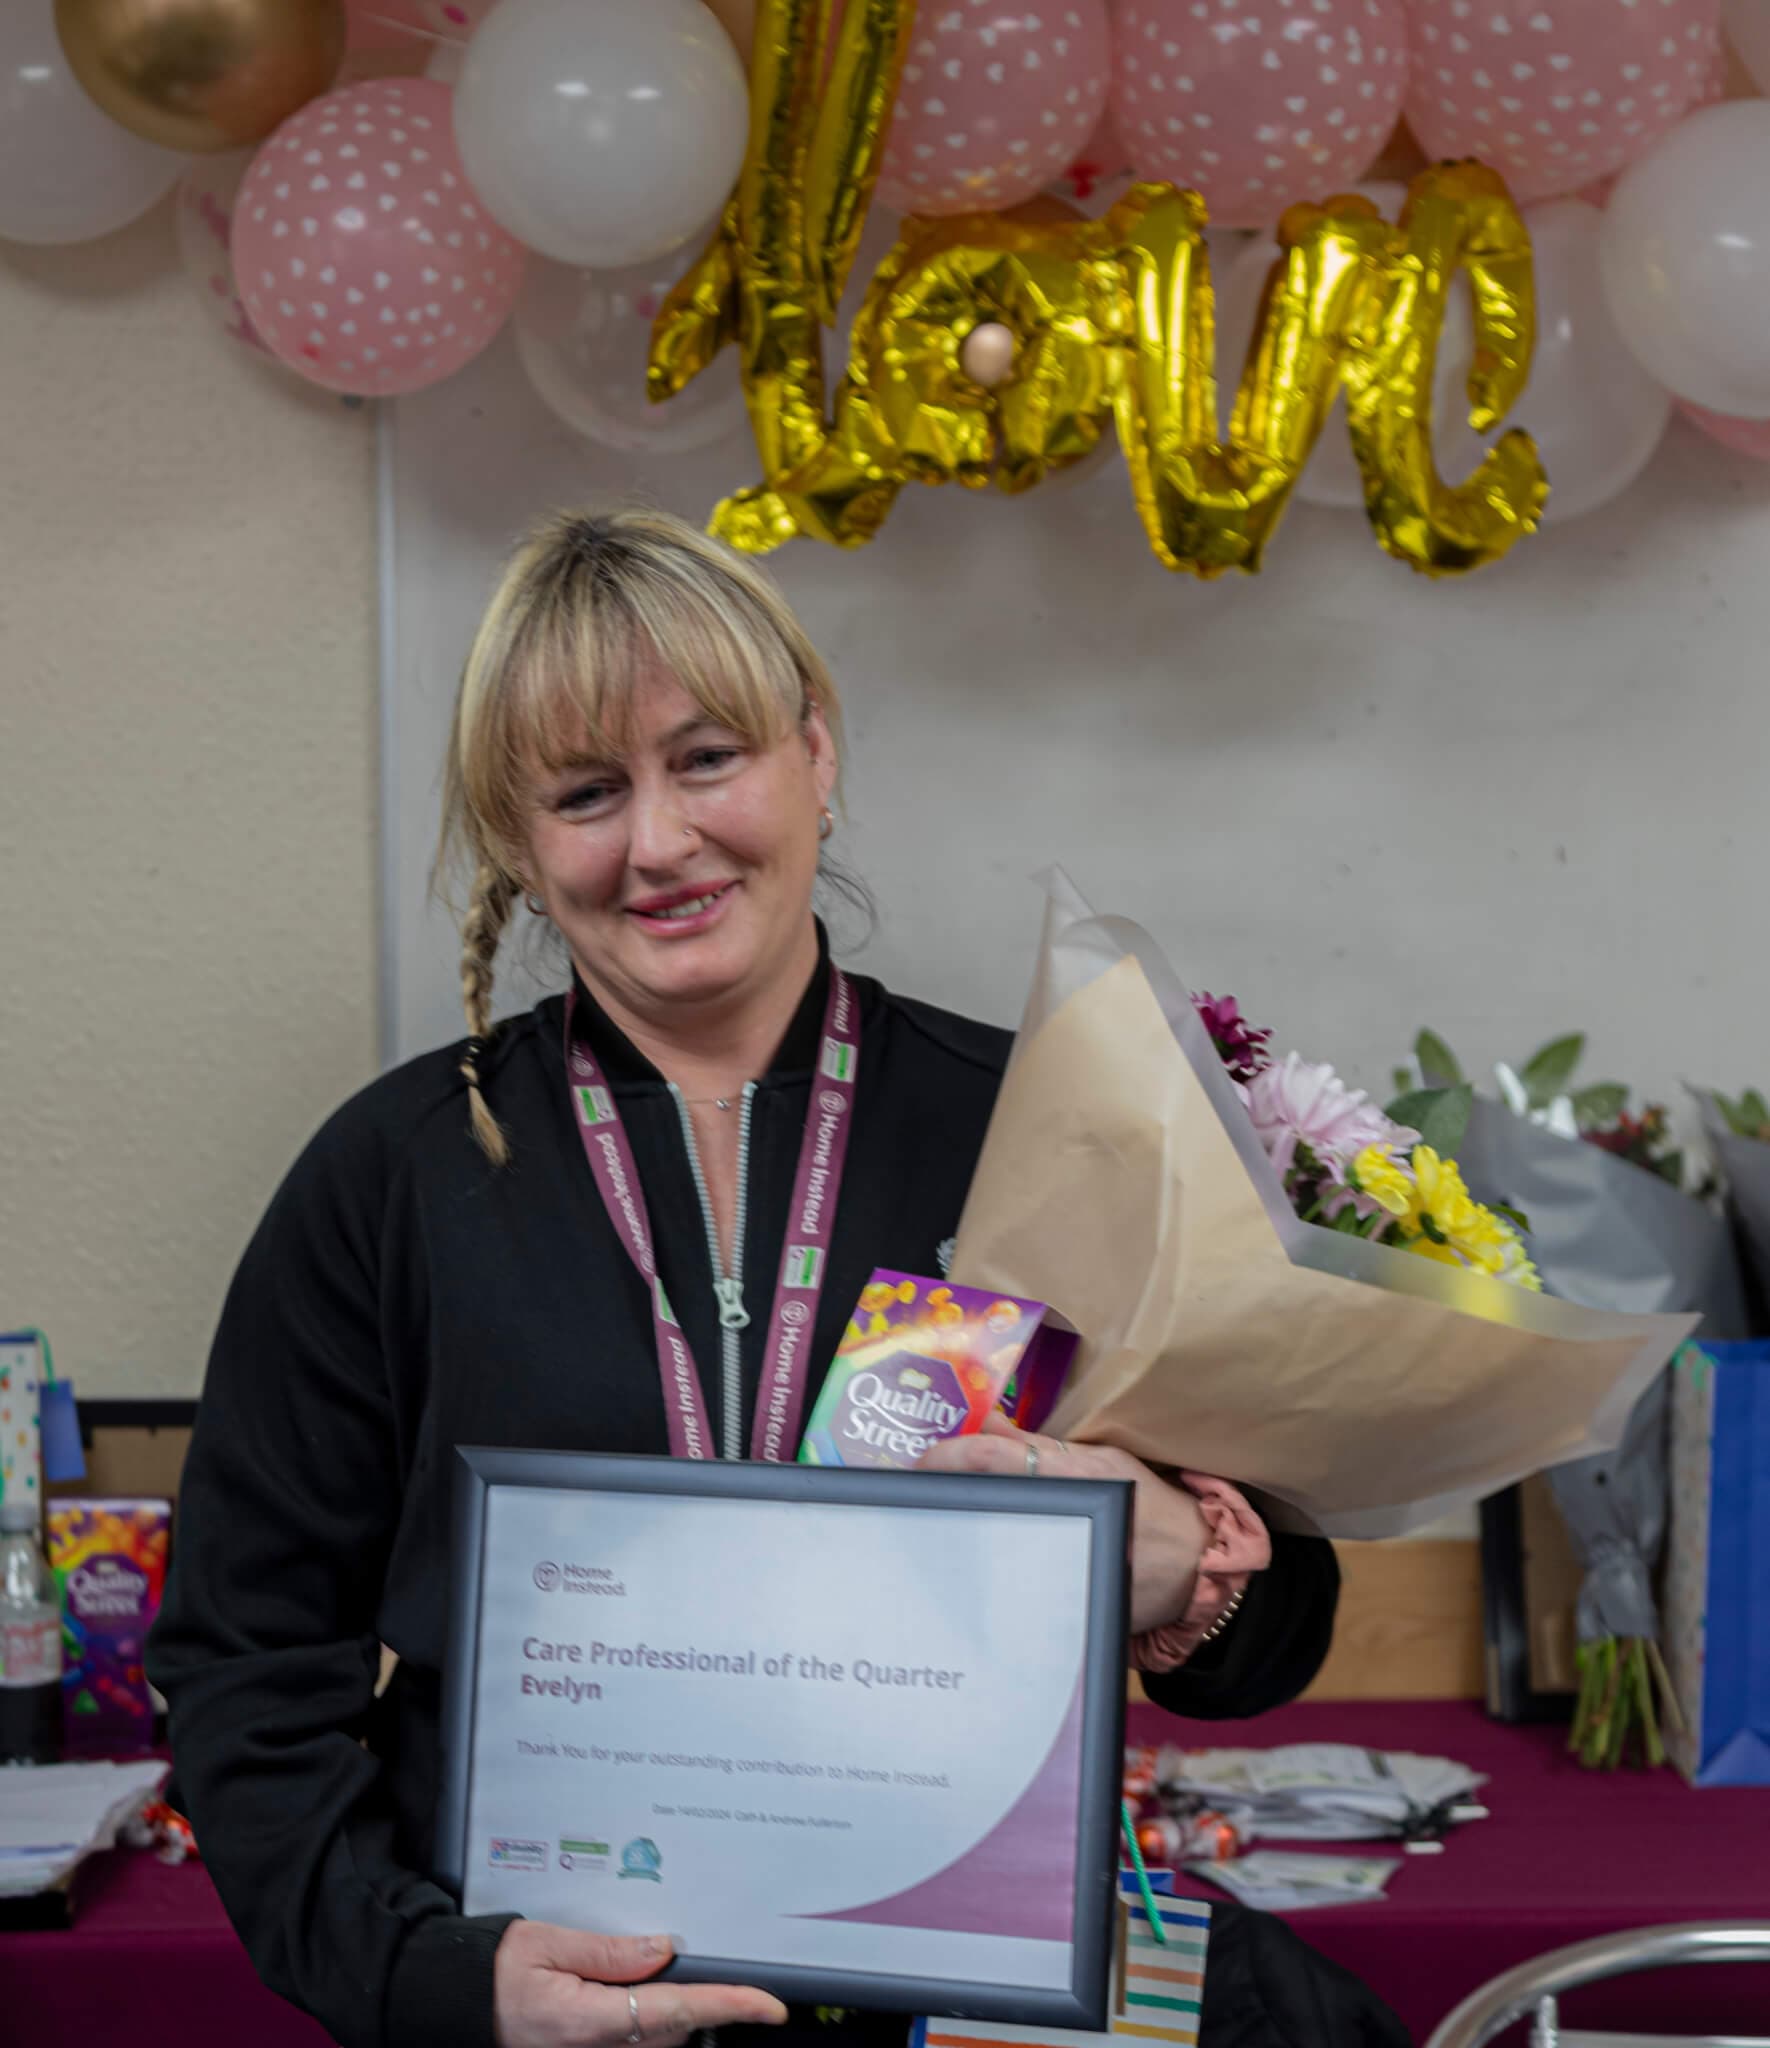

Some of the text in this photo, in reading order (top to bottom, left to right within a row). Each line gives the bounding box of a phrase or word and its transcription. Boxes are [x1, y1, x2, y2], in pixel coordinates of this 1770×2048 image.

[813, 1112, 840, 1167] Home
[800, 1167, 831, 1235] Instead
[773, 1326, 802, 1385] Home
[667, 1336, 705, 1460] ome Instead
[848, 1372, 968, 1434] Quality
[843, 1407, 938, 1458] Stree
[563, 1563, 614, 1580] Home
[520, 1673, 603, 1704] Evelyn
[522, 1636, 965, 1690] Care Professional of the Quarter
[516, 1739, 559, 1757] Thank
[561, 1743, 587, 1760] You
[590, 1744, 611, 1761] for
[613, 1748, 646, 1766] your
[647, 1751, 734, 1775] outstanding
[735, 1758, 824, 1778] contribution
[827, 1765, 844, 1779] to
[846, 1765, 891, 1783] Home
